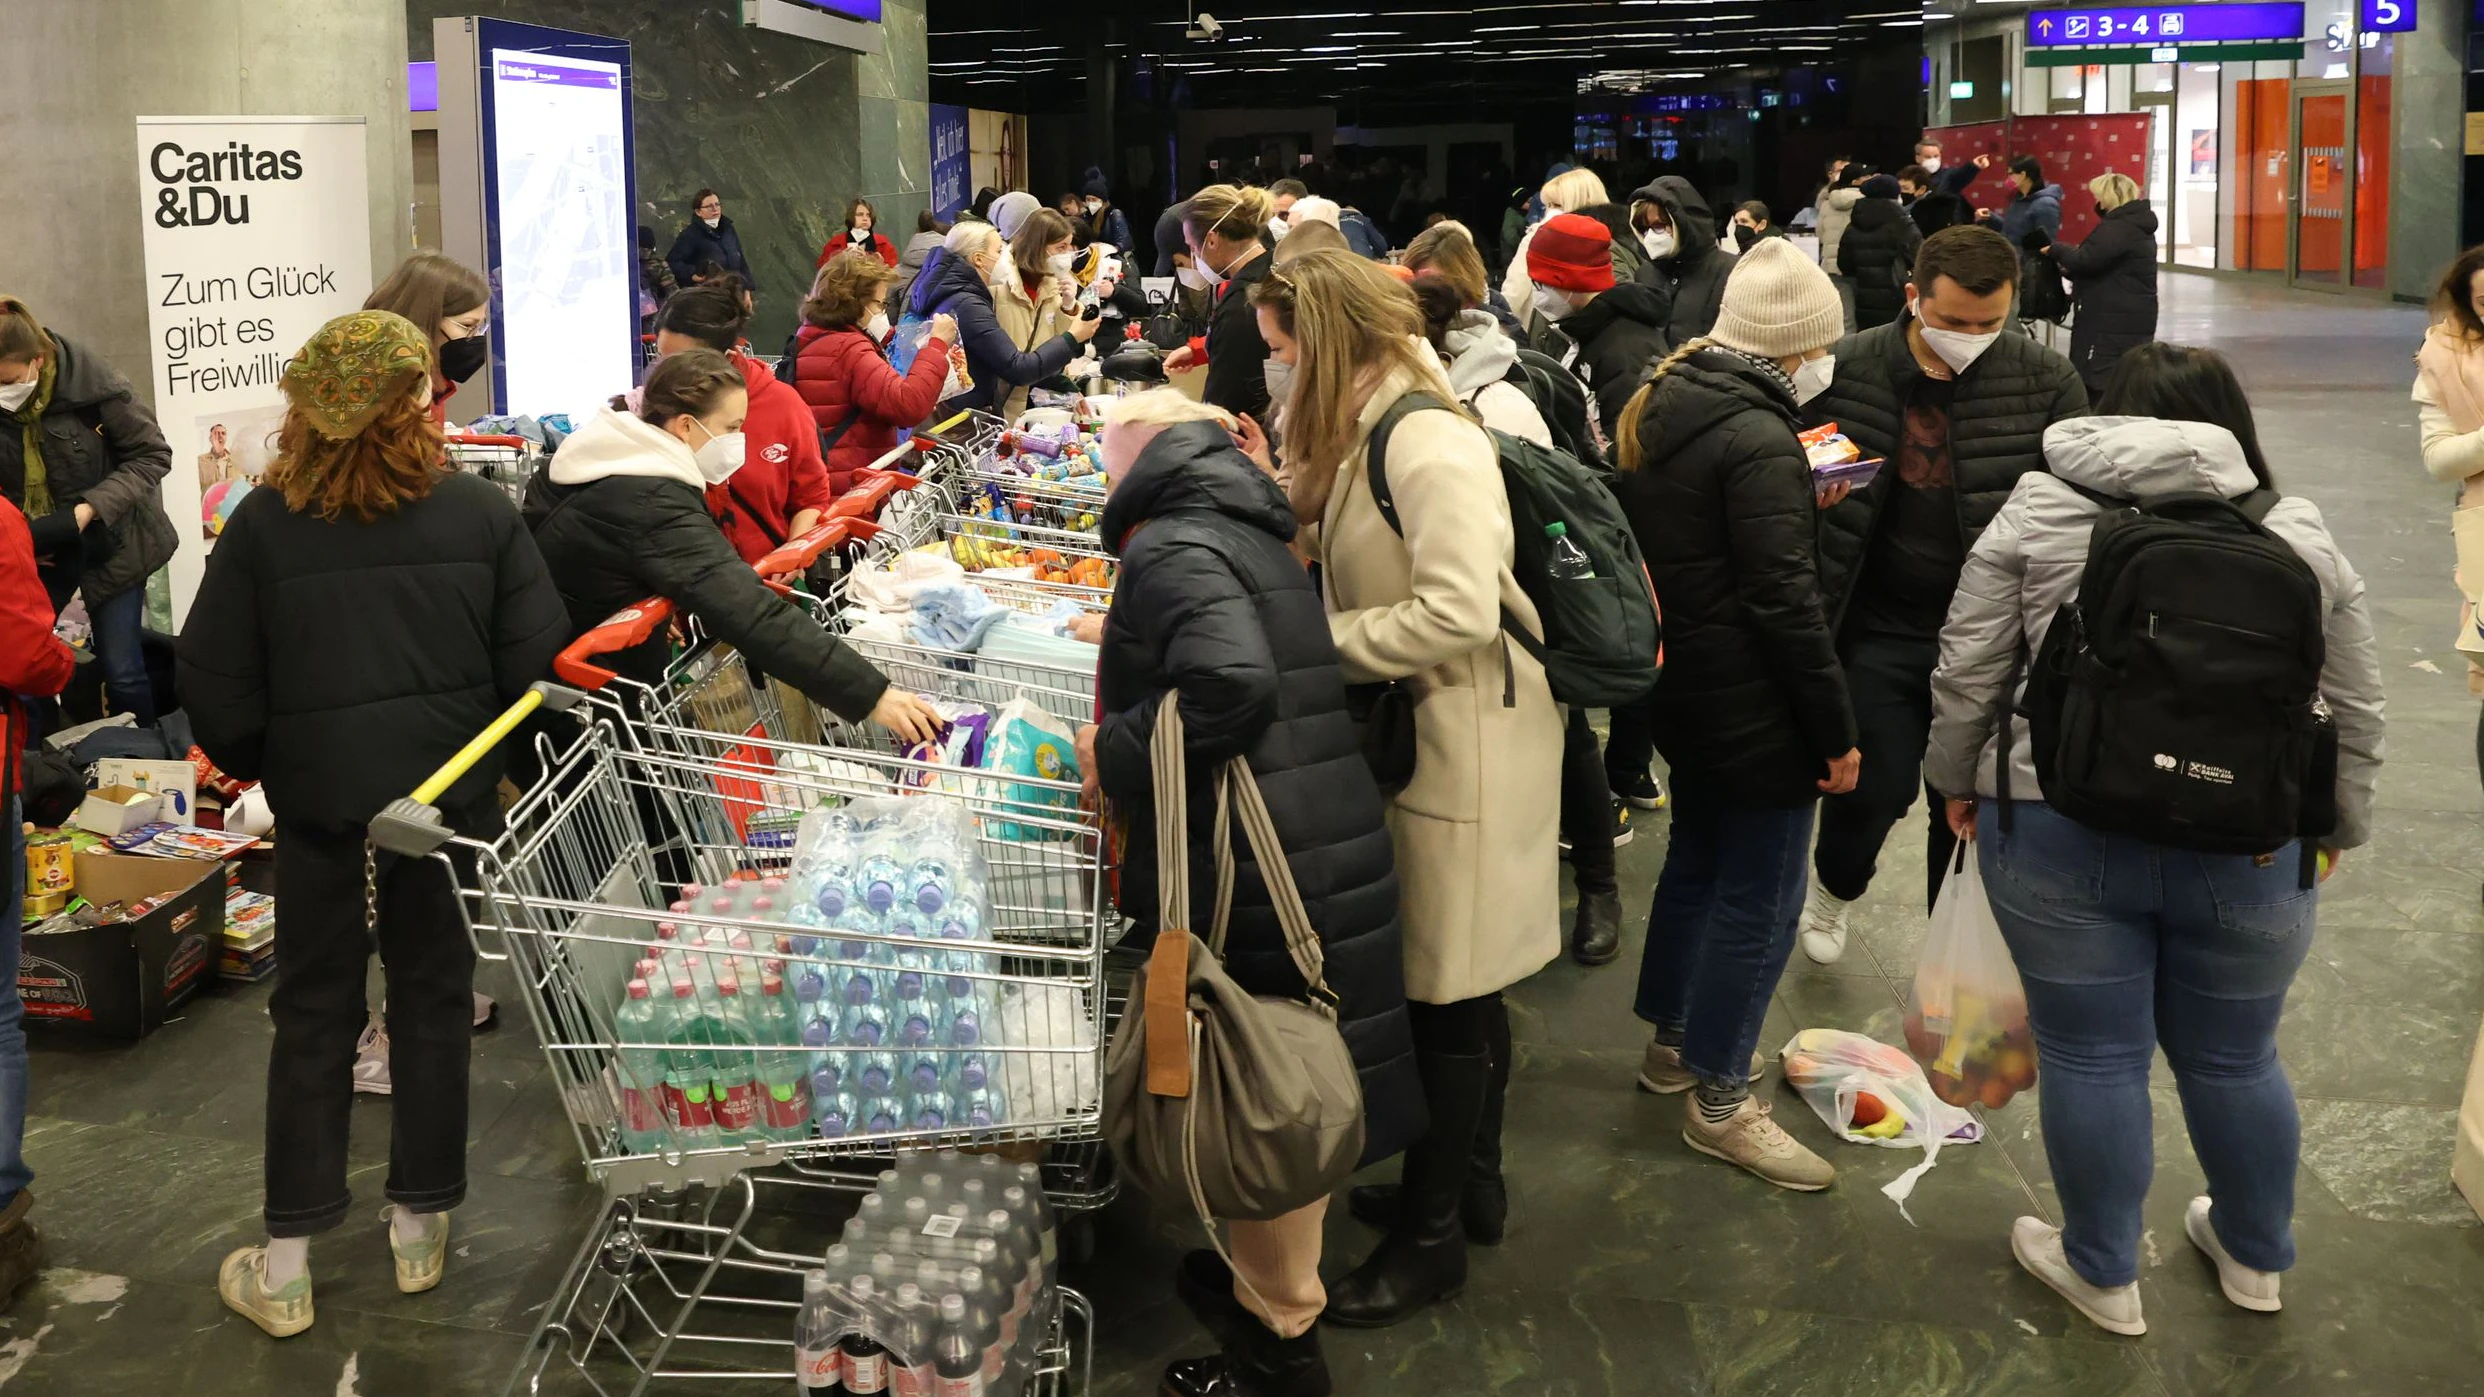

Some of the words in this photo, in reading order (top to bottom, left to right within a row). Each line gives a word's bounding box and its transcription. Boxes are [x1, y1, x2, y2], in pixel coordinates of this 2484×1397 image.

[2375, 0, 2400, 25] 5
[150, 141, 303, 184] Caritas
[154, 185, 250, 229] &Du
[161, 273, 237, 307] Zum
[247, 263, 337, 299] Glück
[165, 316, 228, 360] gibt
[236, 317, 274, 344] es
